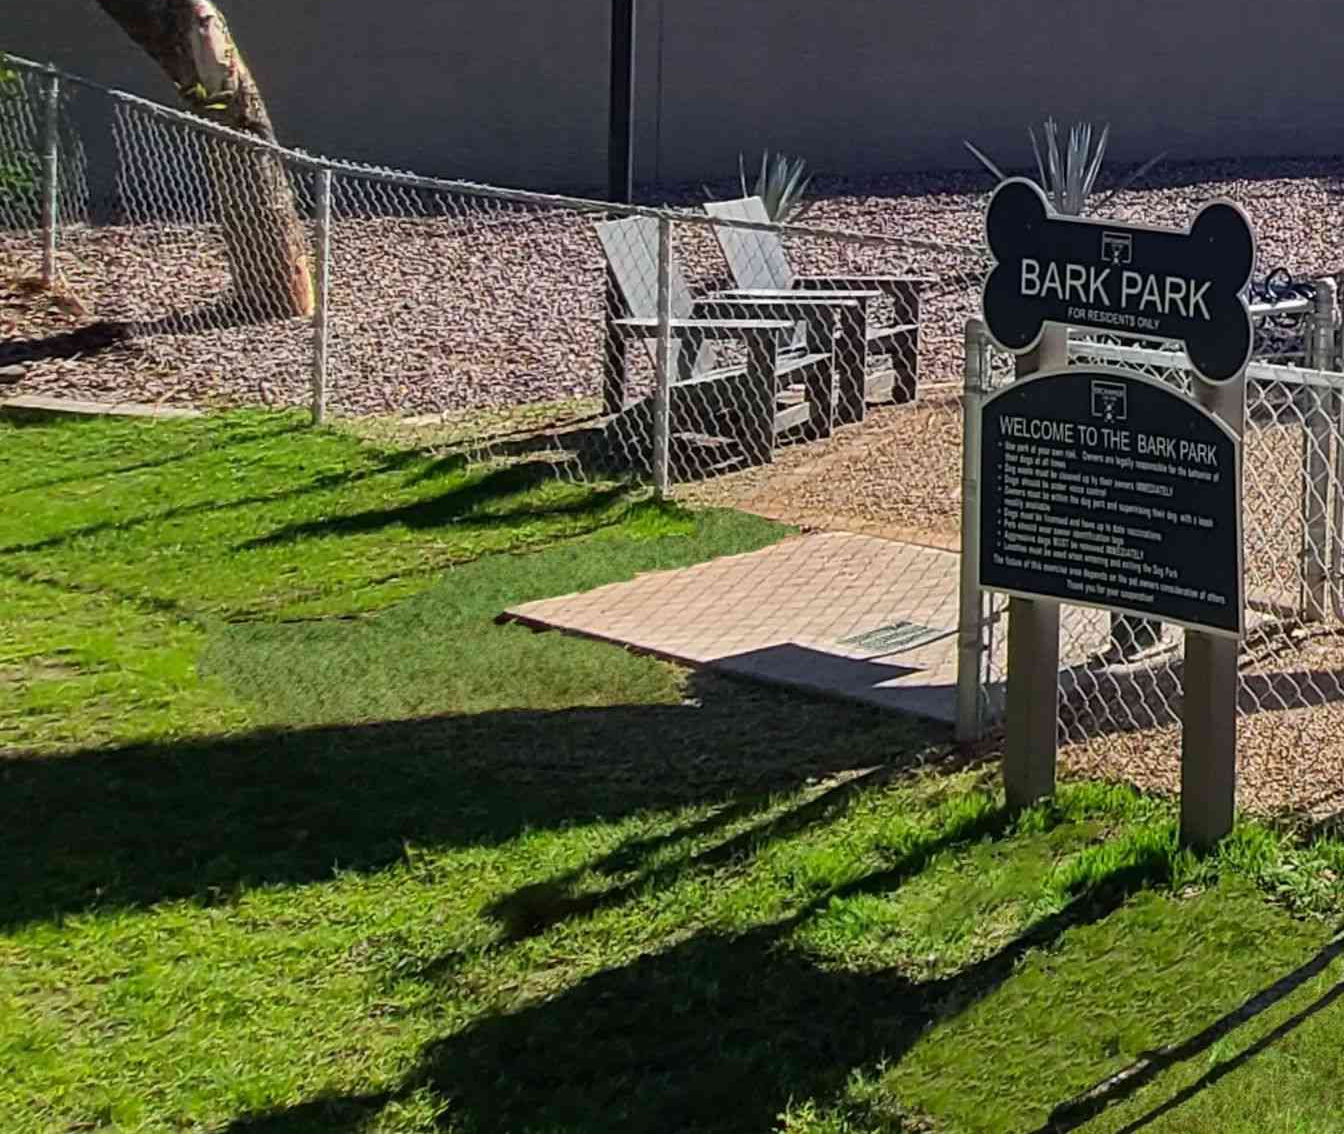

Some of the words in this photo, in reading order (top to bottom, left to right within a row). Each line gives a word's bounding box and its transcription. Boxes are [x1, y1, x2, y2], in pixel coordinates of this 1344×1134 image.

[1021, 258, 1111, 306] BARK
[1121, 270, 1212, 321] PARK
[1067, 307, 1087, 321] FOR
[1087, 309, 1136, 328] RESIDENTS
[1137, 316, 1161, 330] ONLY
[1000, 415, 1075, 443] WELCOME
[1077, 425, 1098, 446] TO
[1100, 428, 1131, 452] THE
[1137, 433, 1177, 459] BARK
[1179, 439, 1218, 467] PARK
